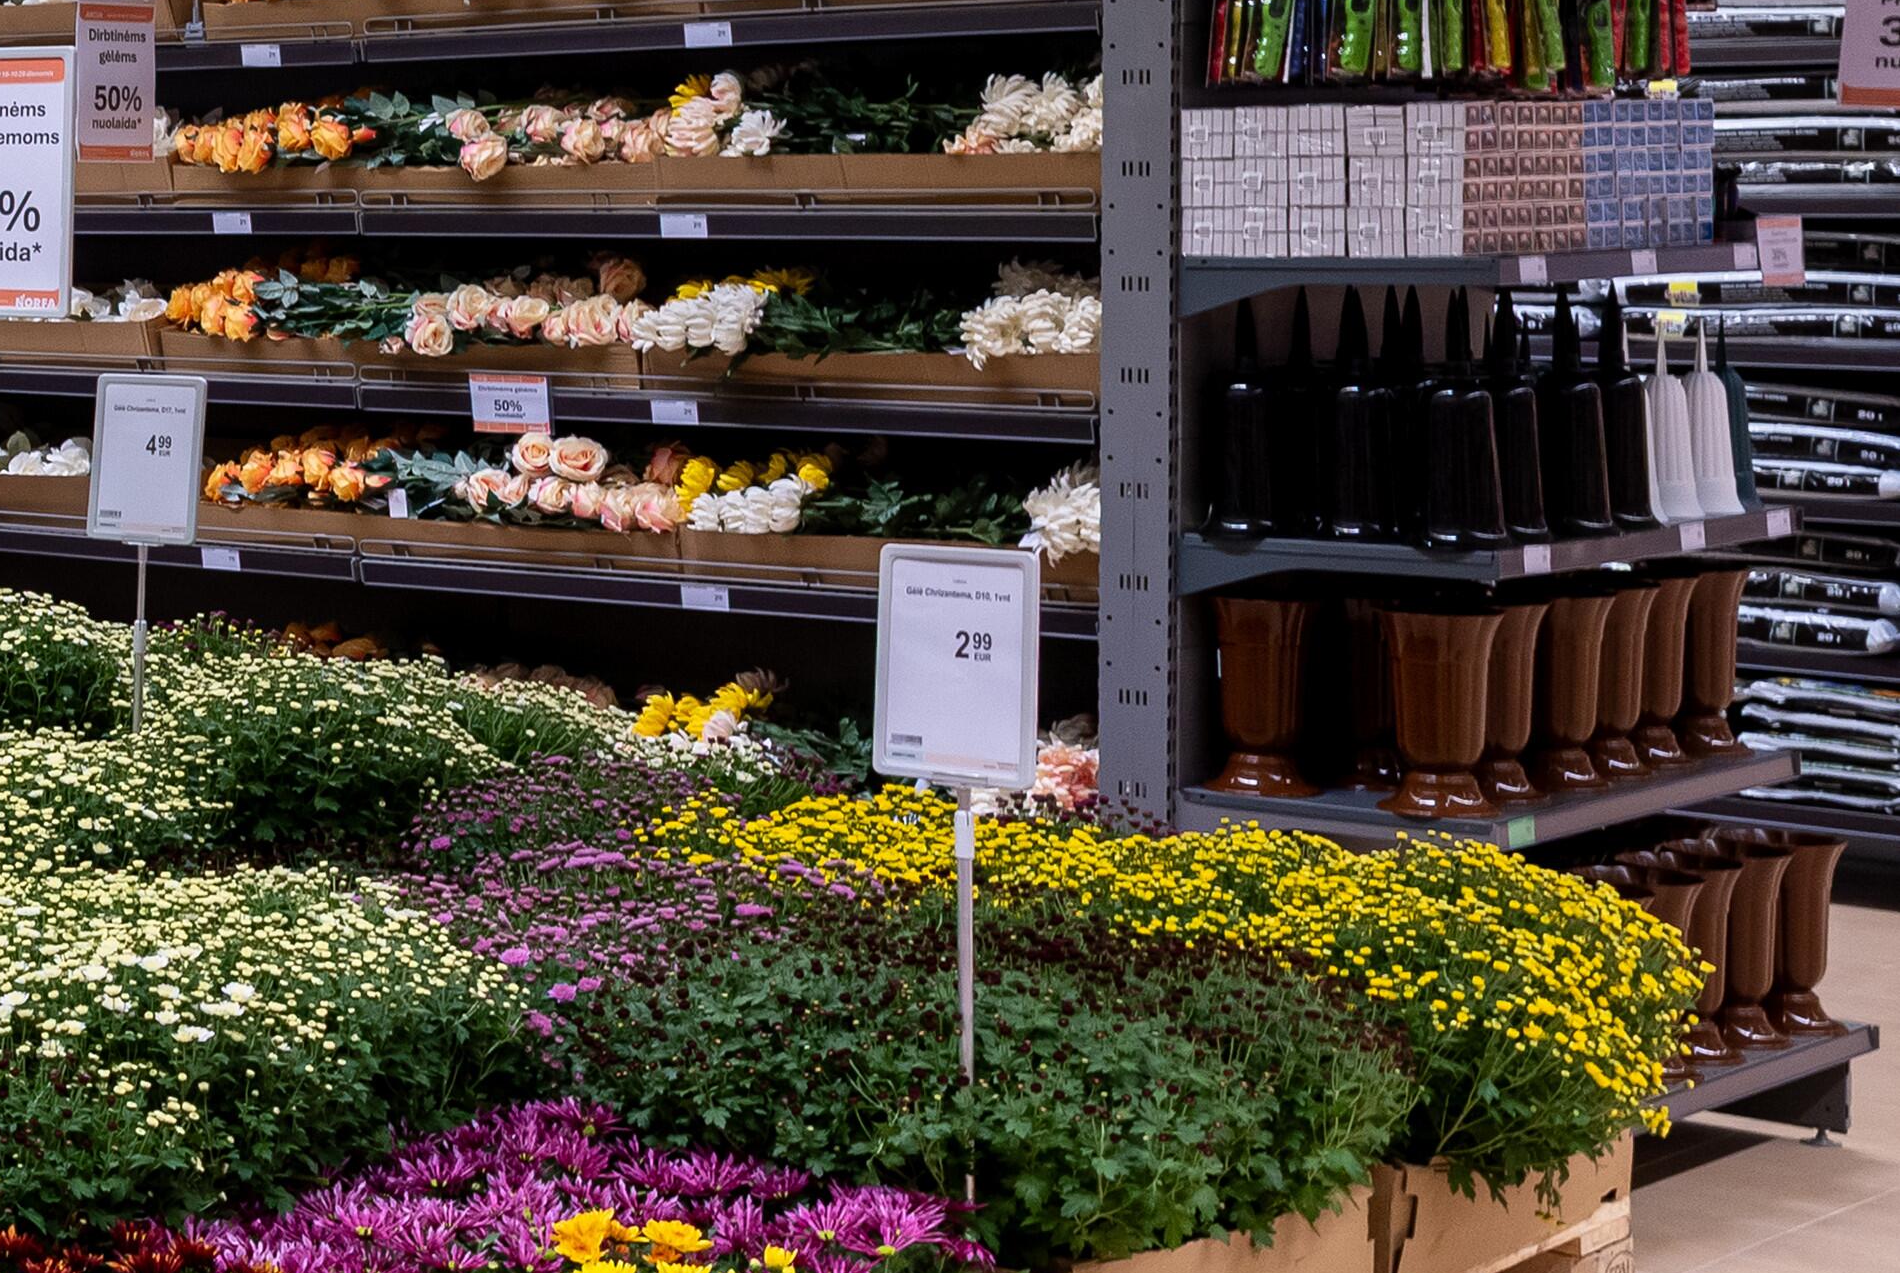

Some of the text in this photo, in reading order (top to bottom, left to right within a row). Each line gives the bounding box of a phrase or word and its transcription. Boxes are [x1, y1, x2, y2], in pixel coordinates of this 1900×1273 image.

[88, 28, 146, 43] Dirbtinėms
[99, 50, 138, 65] gėlėms
[94, 85, 143, 112] 50%
[15, 294, 58, 309] NORFA
[494, 399, 523, 412] 50%
[145, 434, 172, 455] 4 99
[924, 587, 974, 601] Chrizantema,
[954, 630, 993, 659] 2 99
[973, 652, 992, 662] EUR
